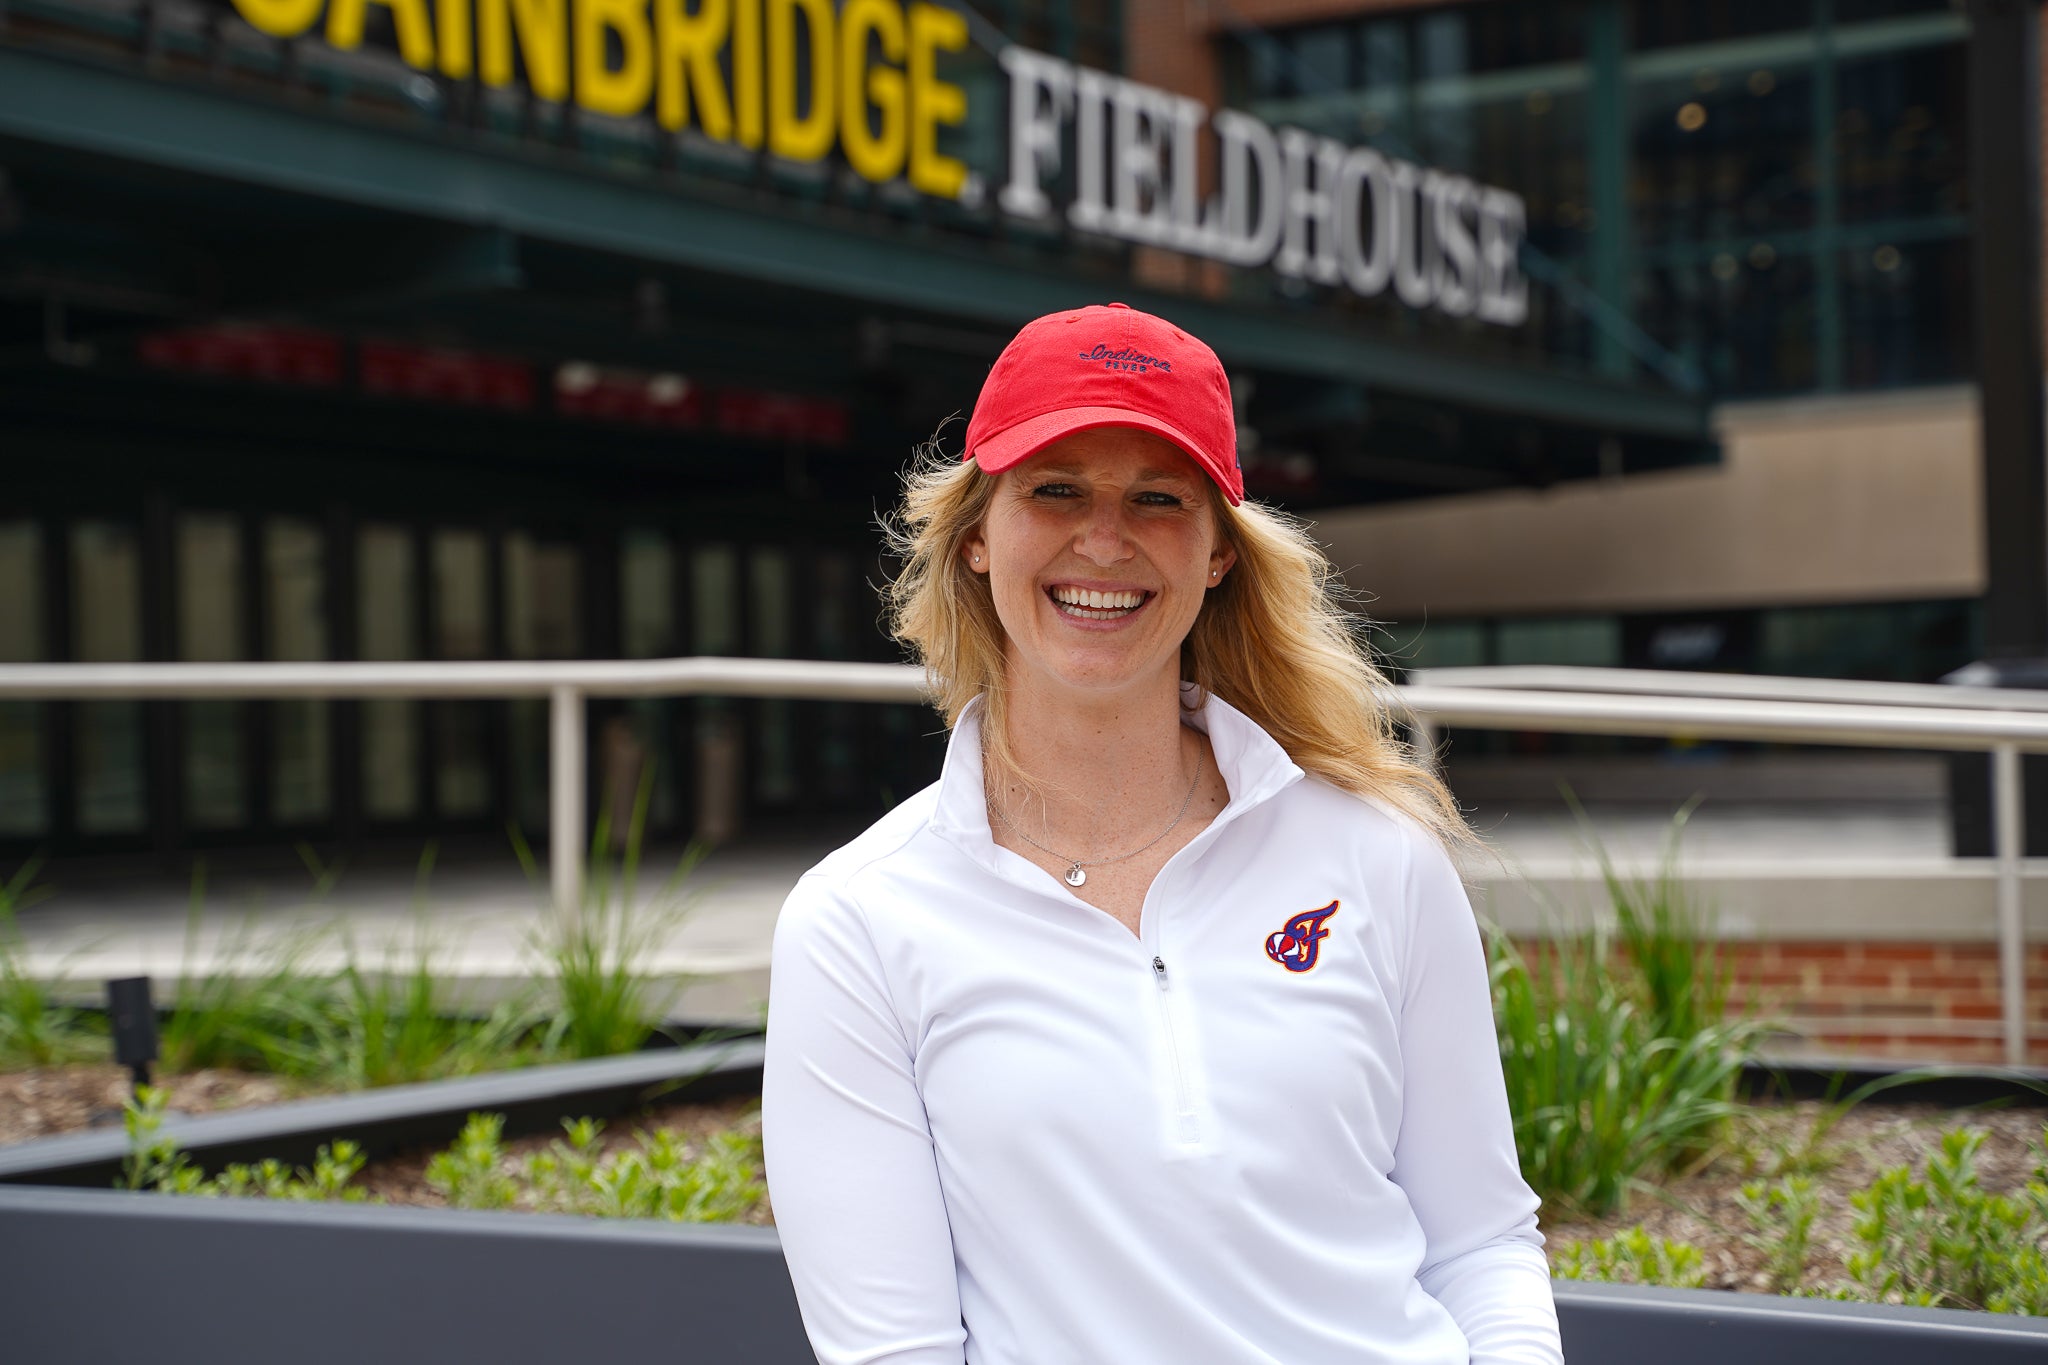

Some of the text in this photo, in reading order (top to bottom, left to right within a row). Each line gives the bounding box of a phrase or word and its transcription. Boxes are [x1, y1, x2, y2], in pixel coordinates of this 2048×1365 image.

[230, 0, 1529, 327] BRIDGE FIELDHOUSE
[1079, 344, 1171, 372] Indiana
[1105, 361, 1147, 372] FEVER
